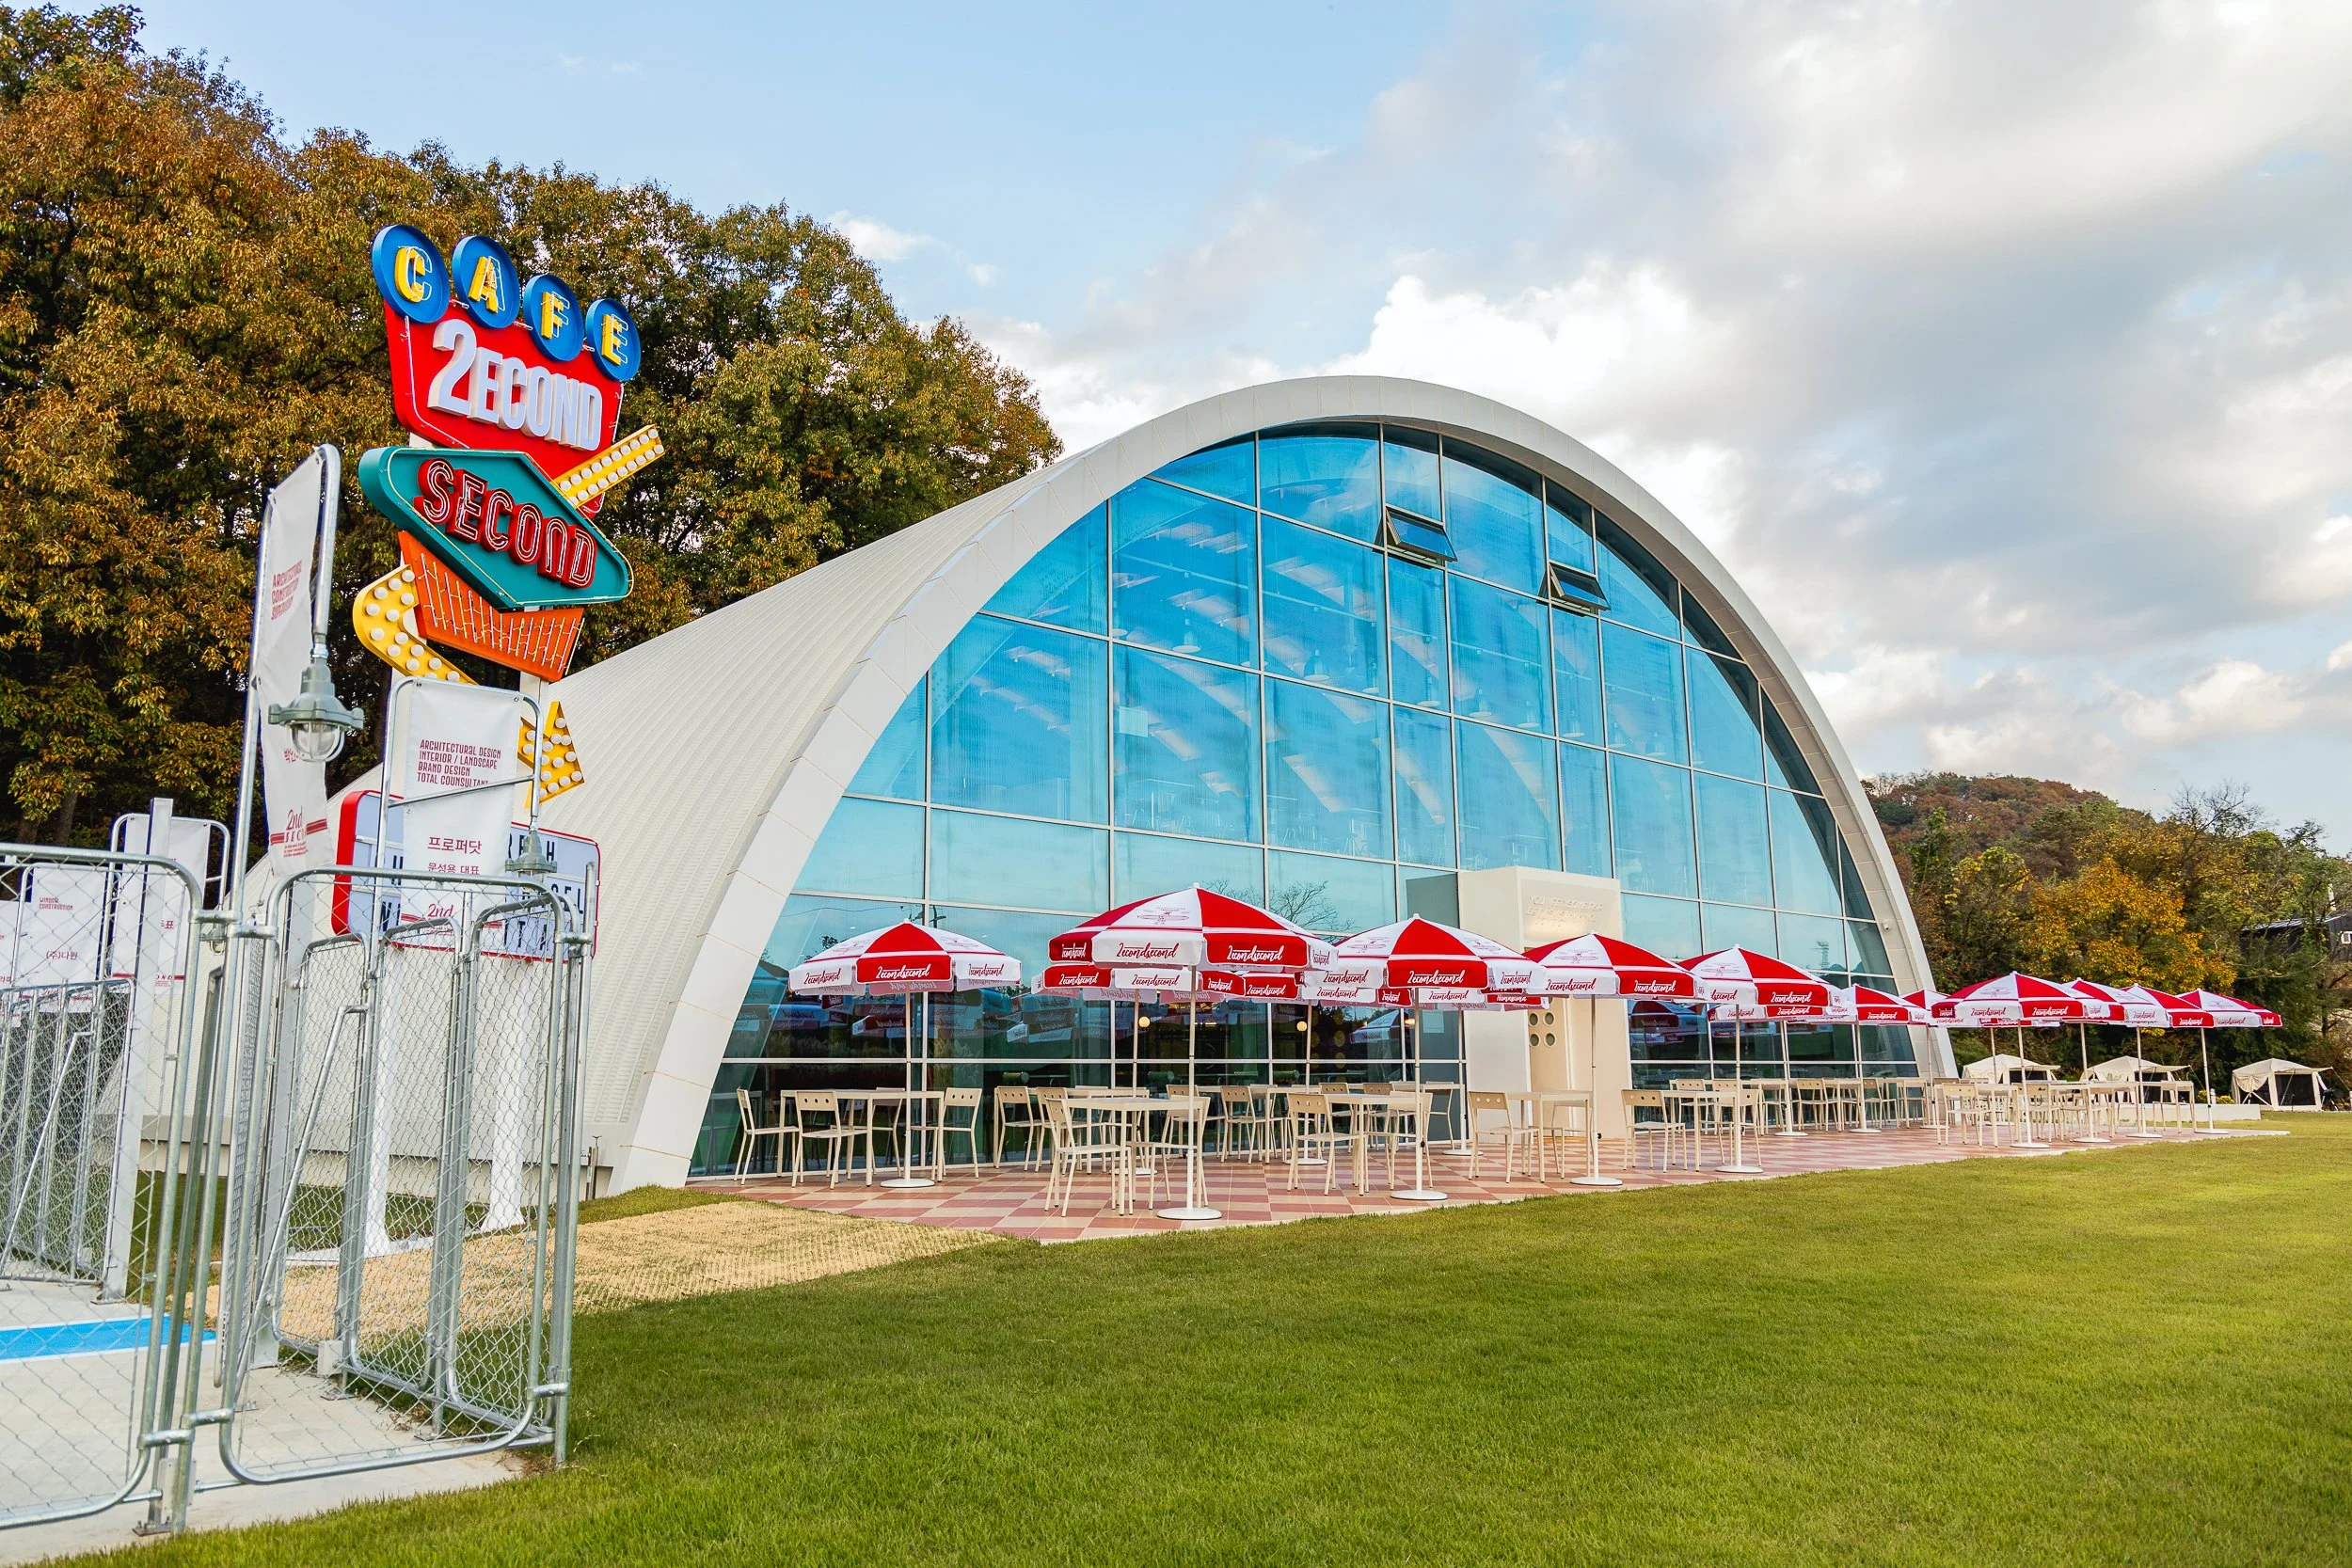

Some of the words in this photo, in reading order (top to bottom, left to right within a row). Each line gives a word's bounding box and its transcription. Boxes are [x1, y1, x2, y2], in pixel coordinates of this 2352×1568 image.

[394, 245, 628, 366] CAFE
[426, 318, 604, 451] 2ECOND
[412, 457, 598, 590] SECOND
[419, 750, 452, 764] INTERIOR
[459, 755, 498, 769] LANDSCAPE
[479, 747, 501, 759] DESIGN
[417, 771, 438, 784] TOTAL
[418, 761, 442, 774] BRAND
[444, 765, 470, 777] DESIGN
[427, 836, 483, 855] 프로퍼닷
